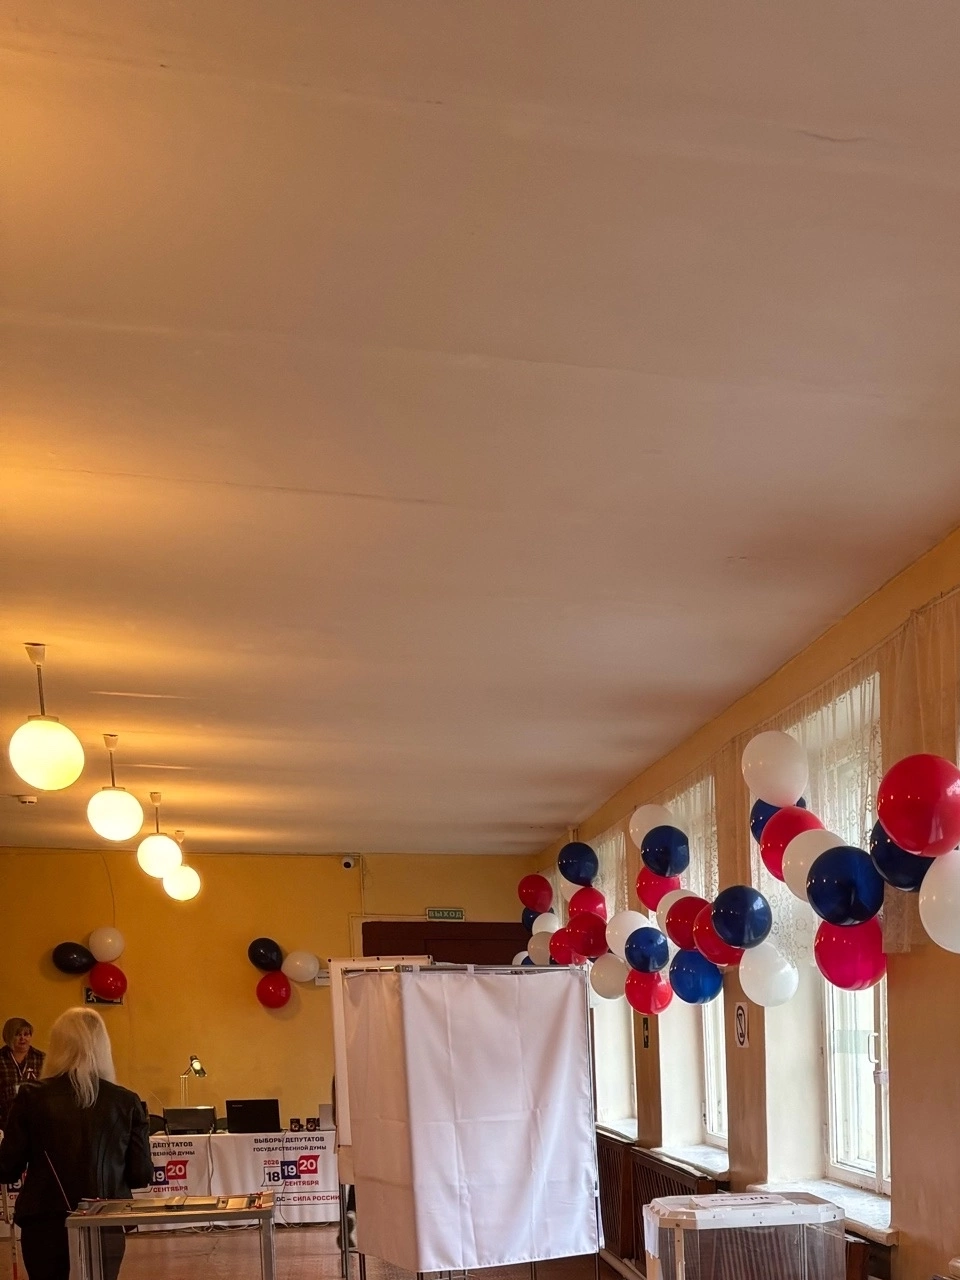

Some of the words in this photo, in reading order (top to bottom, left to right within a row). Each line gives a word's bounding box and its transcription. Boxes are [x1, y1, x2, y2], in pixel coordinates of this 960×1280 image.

[428, 910, 462, 918] ВЫХОД
[167, 1164, 185, 1176] 20
[266, 1171, 281, 1183] 18
[282, 1165, 297, 1177] 19
[299, 1159, 317, 1171] 20
[153, 1185, 189, 1193] СЕНТЯБРЯ
